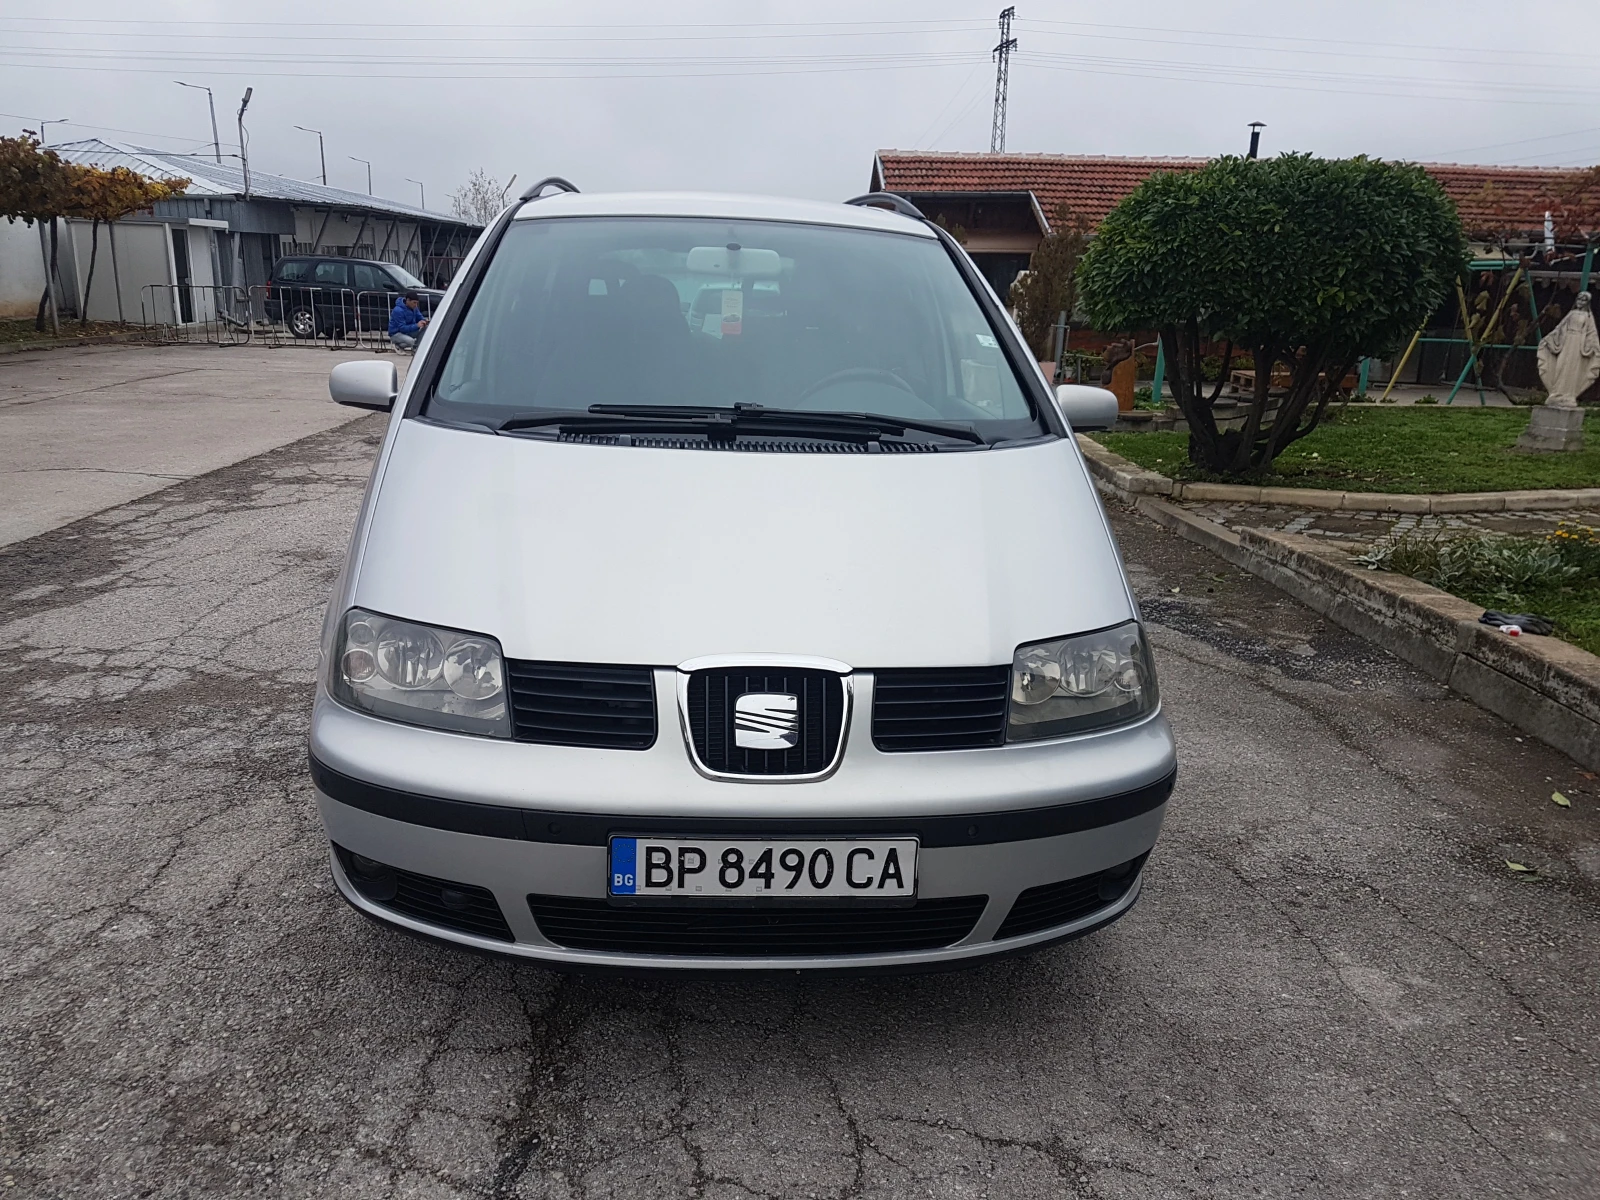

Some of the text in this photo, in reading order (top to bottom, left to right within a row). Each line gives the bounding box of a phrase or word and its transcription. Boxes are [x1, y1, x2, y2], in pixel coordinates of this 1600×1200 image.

[614, 873, 633, 886] BG
[645, 846, 904, 889] BP 8490 CA
